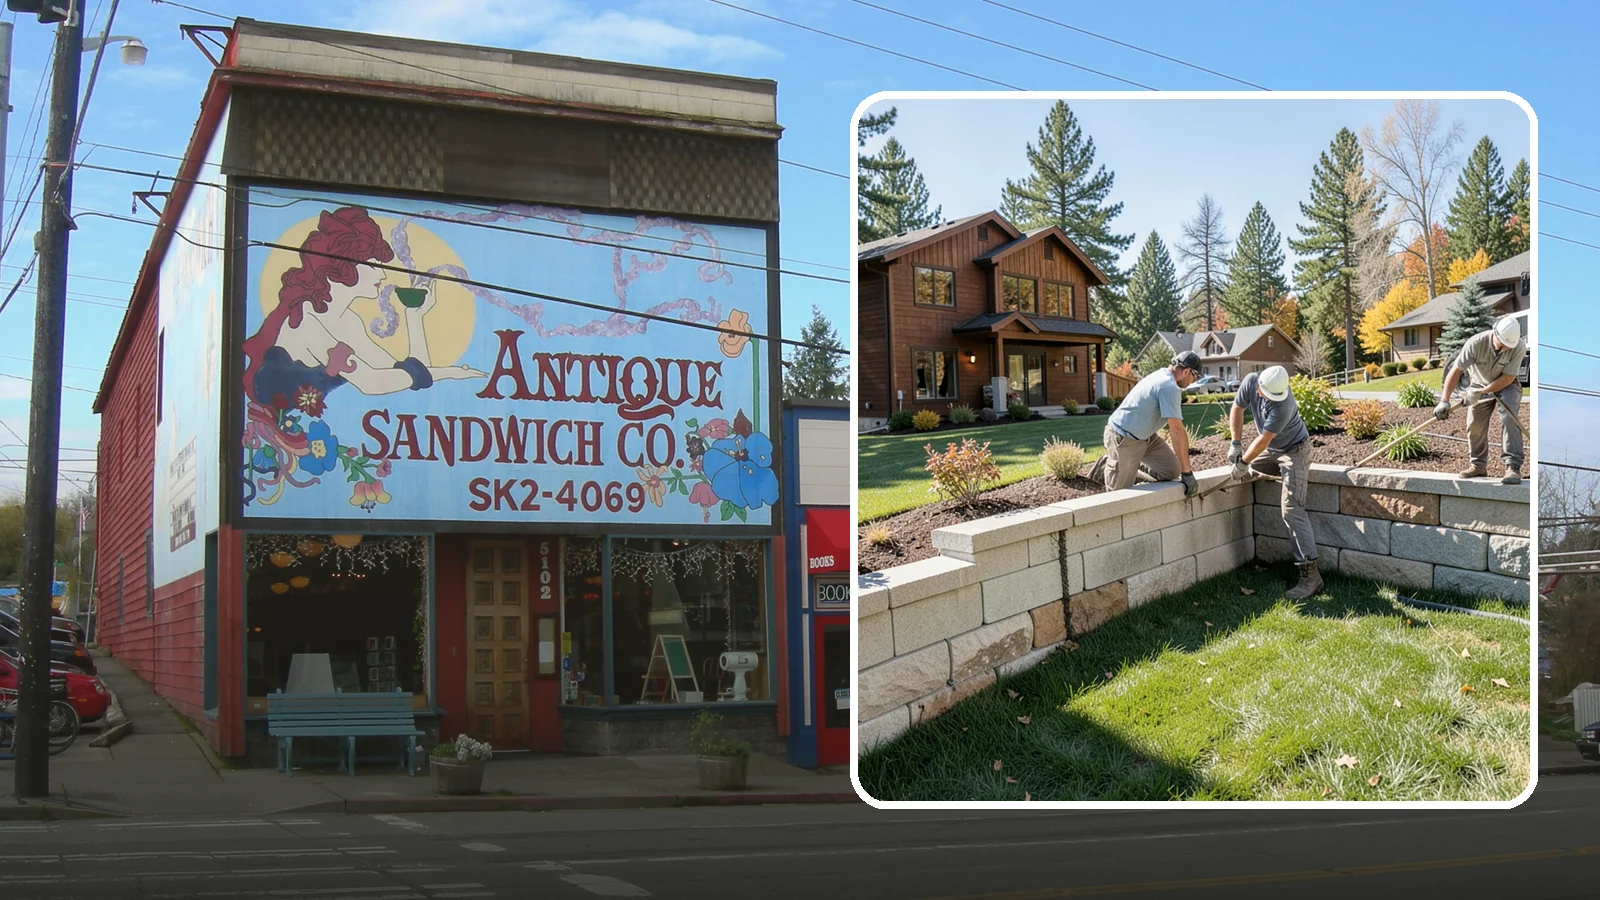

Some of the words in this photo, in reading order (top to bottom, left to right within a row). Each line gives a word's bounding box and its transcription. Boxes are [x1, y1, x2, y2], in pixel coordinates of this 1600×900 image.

[476, 329, 724, 421] ANTIQUE
[361, 408, 605, 467] SANDWICH
[617, 422, 685, 469] CO.
[468, 478, 646, 513] SK2-4069
[540, 542, 551, 600] 5102
[810, 555, 834, 569] BOOKS
